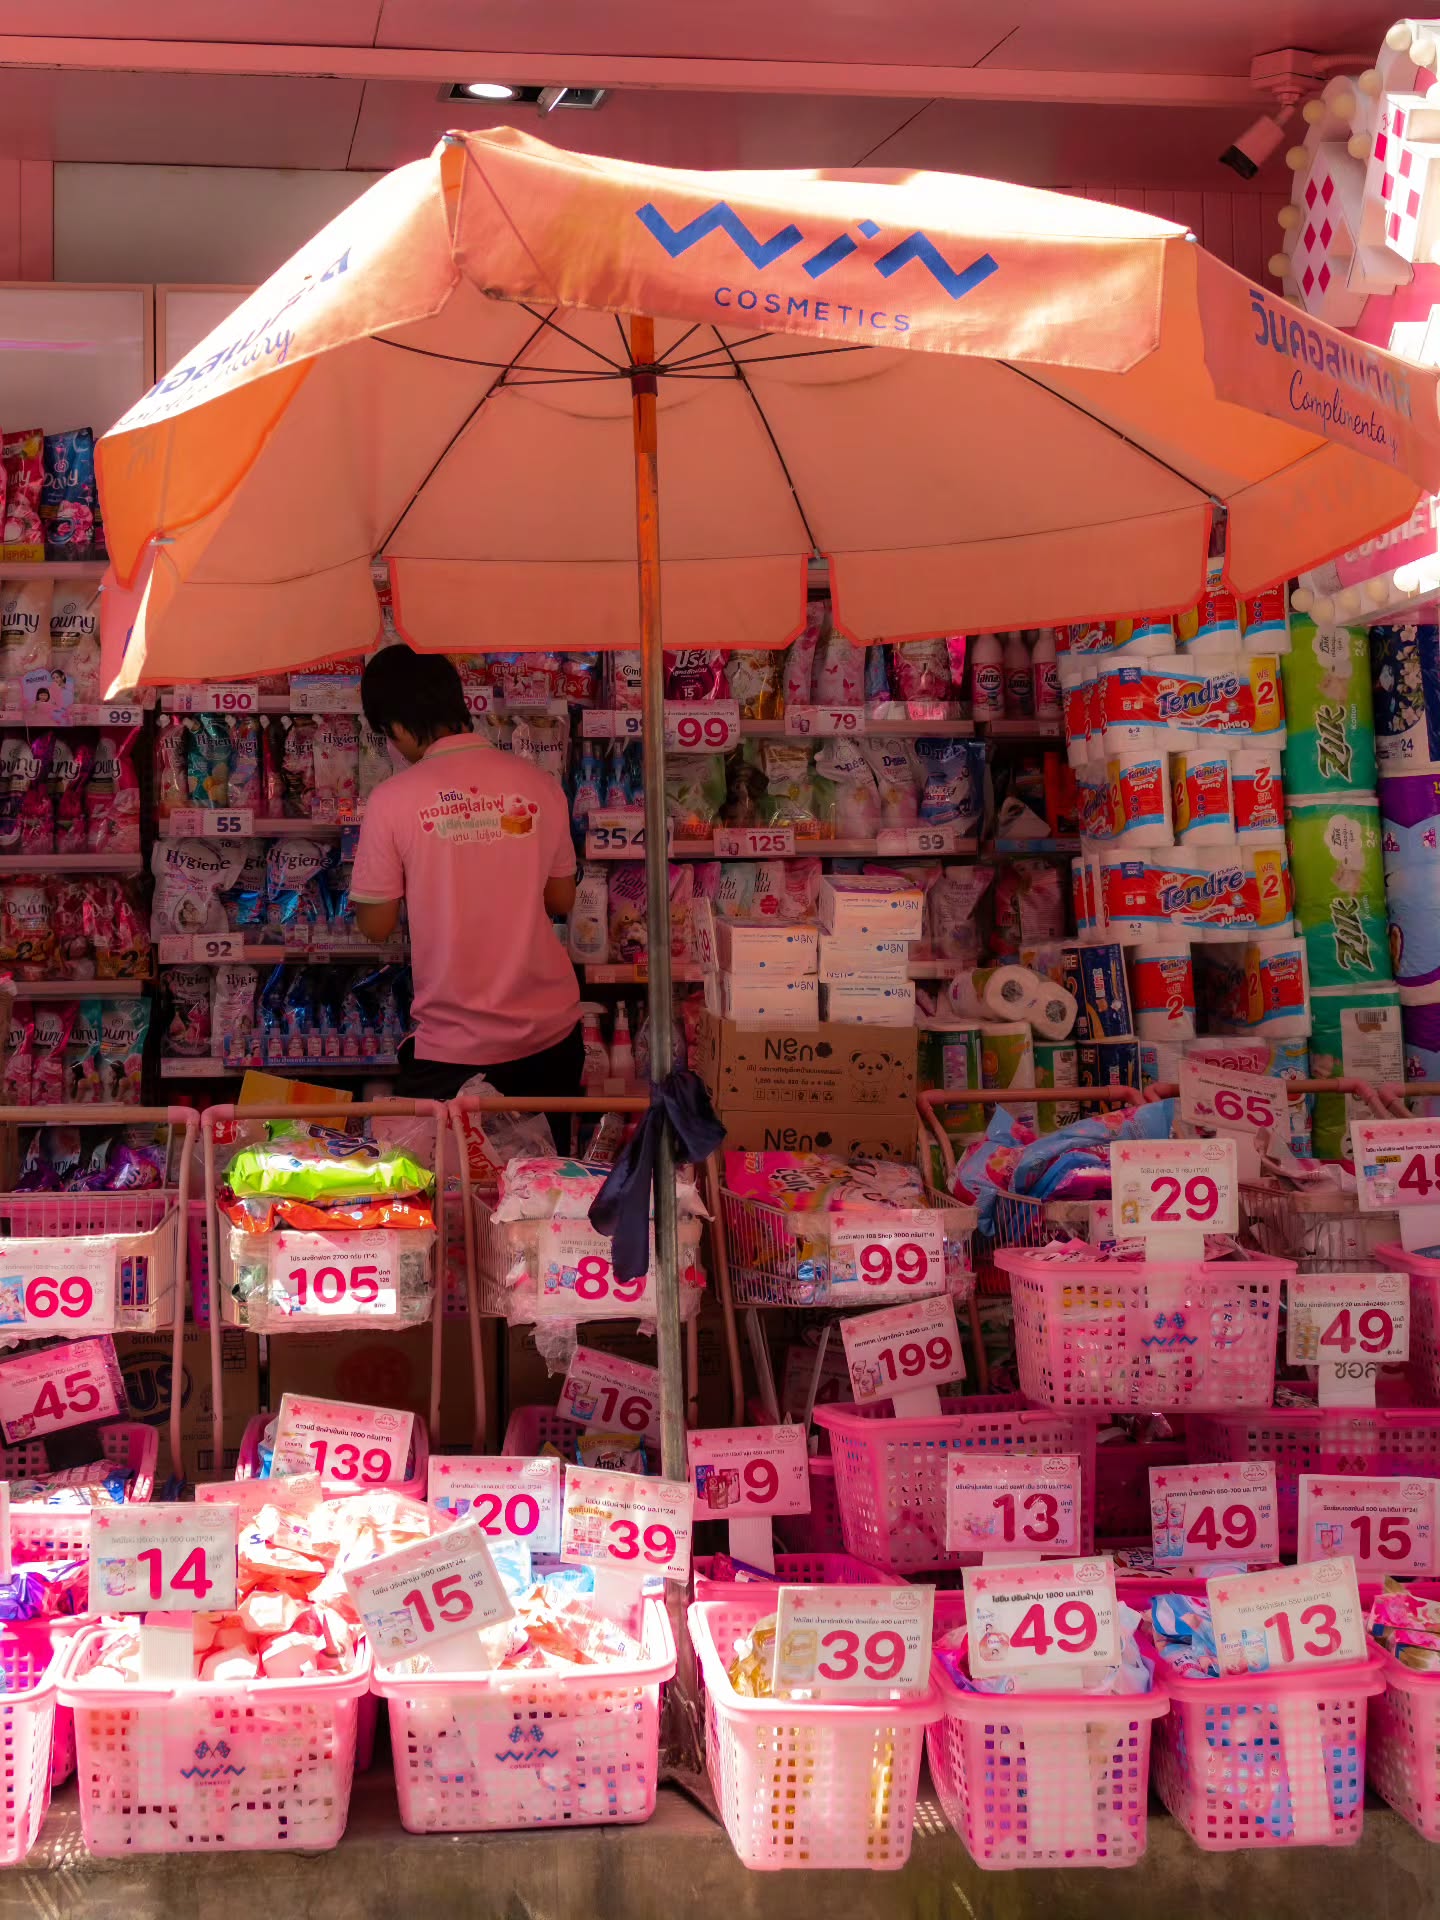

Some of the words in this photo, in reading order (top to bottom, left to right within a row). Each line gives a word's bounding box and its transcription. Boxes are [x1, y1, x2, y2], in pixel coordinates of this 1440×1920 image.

[714, 287, 911, 332] COSMETICS
[50, 615, 95, 634] owny
[212, 694, 252, 710] 190
[464, 695, 488, 711] 90
[684, 688, 695, 697] 15
[1156, 676, 1240, 718] Tendre
[1257, 681, 1274, 706] 2
[109, 710, 132, 724] 99
[830, 713, 857, 730] 79
[1214, 719, 1250, 732] JUMBO
[198, 735, 231, 752] Hygien
[323, 733, 360, 748] Hygien
[366, 733, 387, 748] Hygi
[677, 717, 729, 747] 99
[1400, 738, 1414, 751] 24
[1127, 765, 1158, 781] Tendre
[1194, 766, 1224, 779] Tendre
[216, 816, 242, 833] 55
[749, 835, 786, 852] 125
[918, 834, 944, 850] 89
[166, 850, 231, 873] Hygiene
[269, 848, 332, 869] Hygiene
[1158, 870, 1246, 913] Tendre
[1263, 875, 1279, 899] 2
[1219, 914, 1255, 927] JUMBO
[205, 940, 232, 957] 92
[226, 974, 258, 988] Hygie
[1166, 995, 1185, 1020] 2
[102, 1029, 140, 1046] owny
[1214, 1090, 1274, 1127] 65
[1398, 1153, 1440, 1196] 4
[1150, 1175, 1219, 1222] 29
[859, 1242, 928, 1286] 99
[25, 1276, 93, 1318] 69
[288, 1265, 379, 1306] 105
[1320, 1308, 1394, 1354] 49
[878, 1336, 953, 1381] 199
[32, 1369, 100, 1420] 45
[600, 1387, 653, 1431] 16
[309, 1440, 392, 1483] 139
[595, 1455, 626, 1469] Attack
[743, 1458, 779, 1504] 9
[472, 1493, 540, 1536] 20
[992, 1493, 1060, 1543] 13
[1186, 1503, 1257, 1551] 49
[607, 1519, 677, 1564] 39
[1350, 1515, 1412, 1560] 15
[137, 1547, 213, 1600] 14
[402, 1574, 474, 1633] 15
[1045, 1590, 1064, 1598] 1800
[1009, 1600, 1098, 1656] 49
[1263, 1603, 1342, 1663] 13
[818, 1629, 906, 1681] 39
